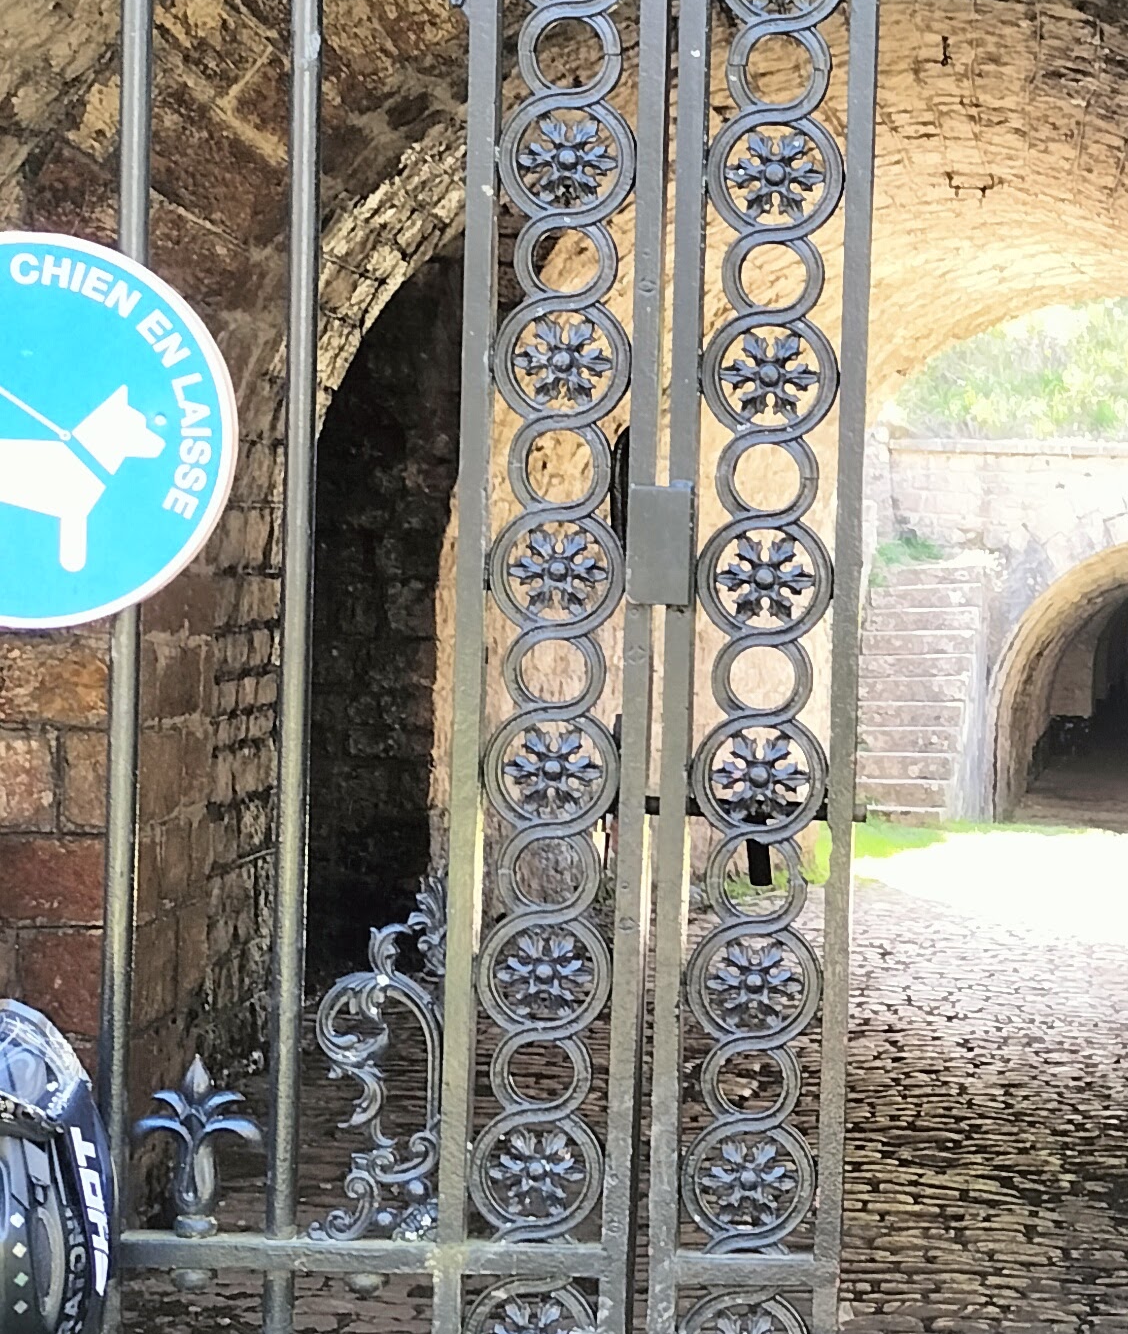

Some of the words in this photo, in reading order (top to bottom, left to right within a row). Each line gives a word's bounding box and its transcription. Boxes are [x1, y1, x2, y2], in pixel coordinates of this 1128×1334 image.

[10, 253, 142, 318] CHIEN
[136, 309, 192, 368] EN
[162, 372, 213, 520] LAISSE
